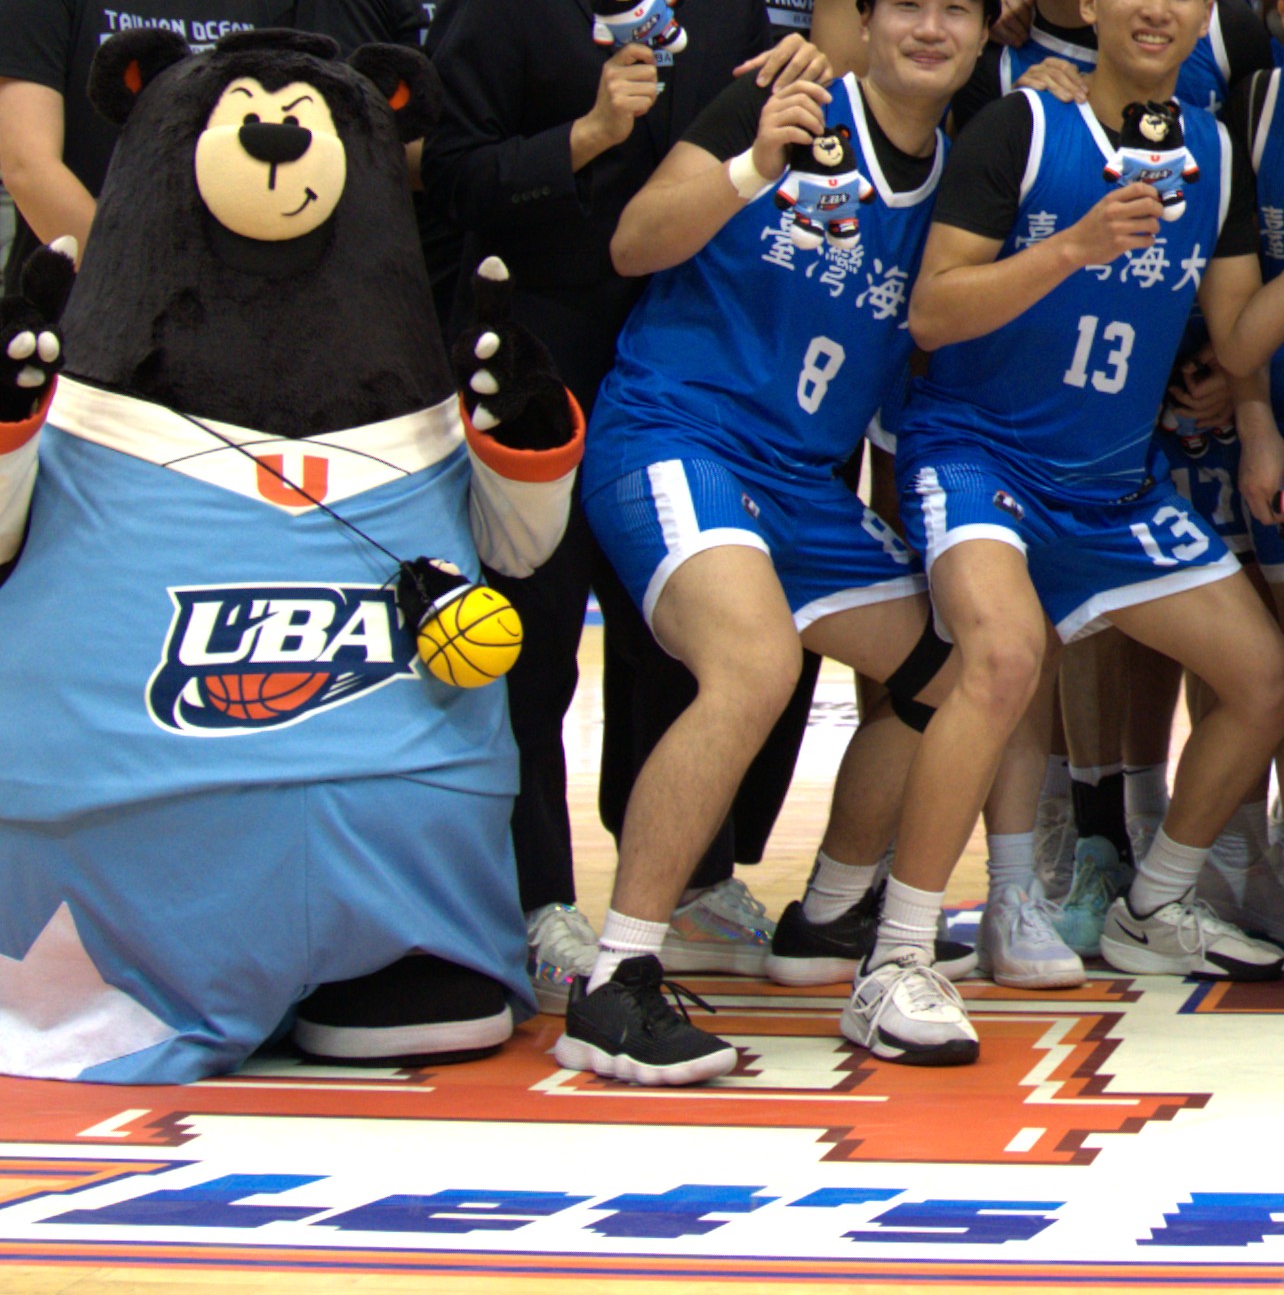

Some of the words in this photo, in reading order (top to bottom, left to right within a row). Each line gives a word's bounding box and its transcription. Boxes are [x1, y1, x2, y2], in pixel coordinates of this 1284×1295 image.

[796, 335, 846, 416] 8
[1062, 314, 1136, 396] 13
[255, 453, 329, 509] U
[1128, 505, 1210, 567] 13
[178, 597, 395, 668] UBA
[30, 1172, 1066, 1245] Let's
